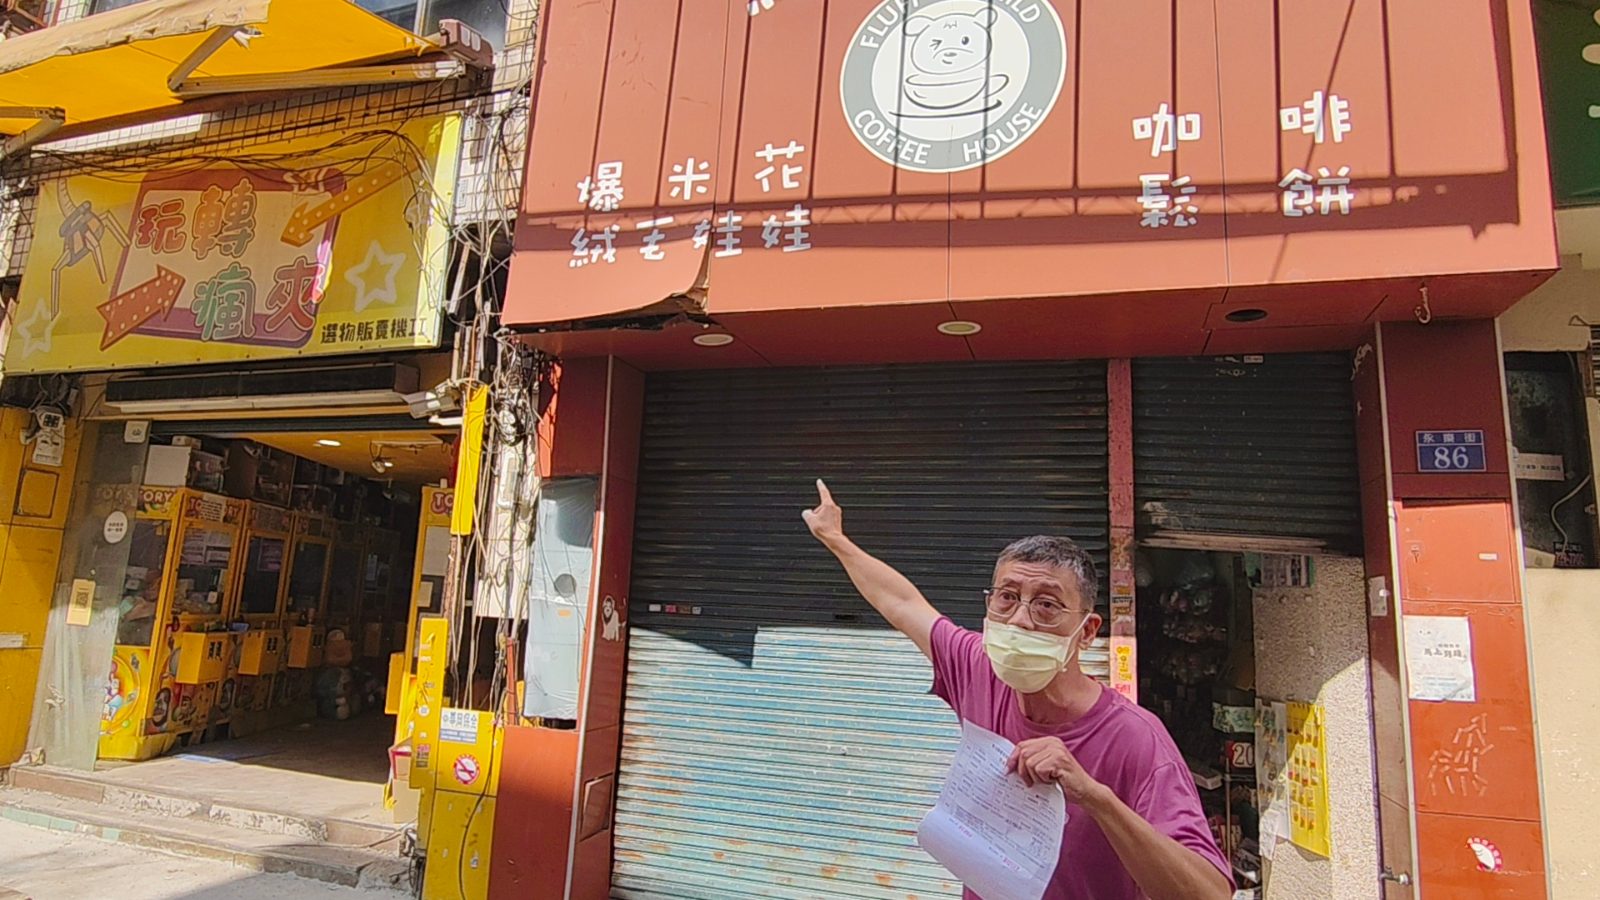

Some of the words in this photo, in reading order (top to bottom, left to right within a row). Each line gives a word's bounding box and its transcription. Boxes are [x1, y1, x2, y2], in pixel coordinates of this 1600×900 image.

[854, 110, 931, 164] COFFEE
[962, 102, 1042, 163] HOUSE
[1132, 90, 1351, 157] 咖啡
[577, 141, 805, 212] 爆米花
[1137, 165, 1354, 228] 鬆餅
[135, 178, 257, 260] 玩轉
[569, 203, 811, 267] 絨毛娃娃
[192, 256, 326, 341] 瘋夾
[1434, 446, 1469, 469] 86
[1234, 744, 1256, 766] 20
